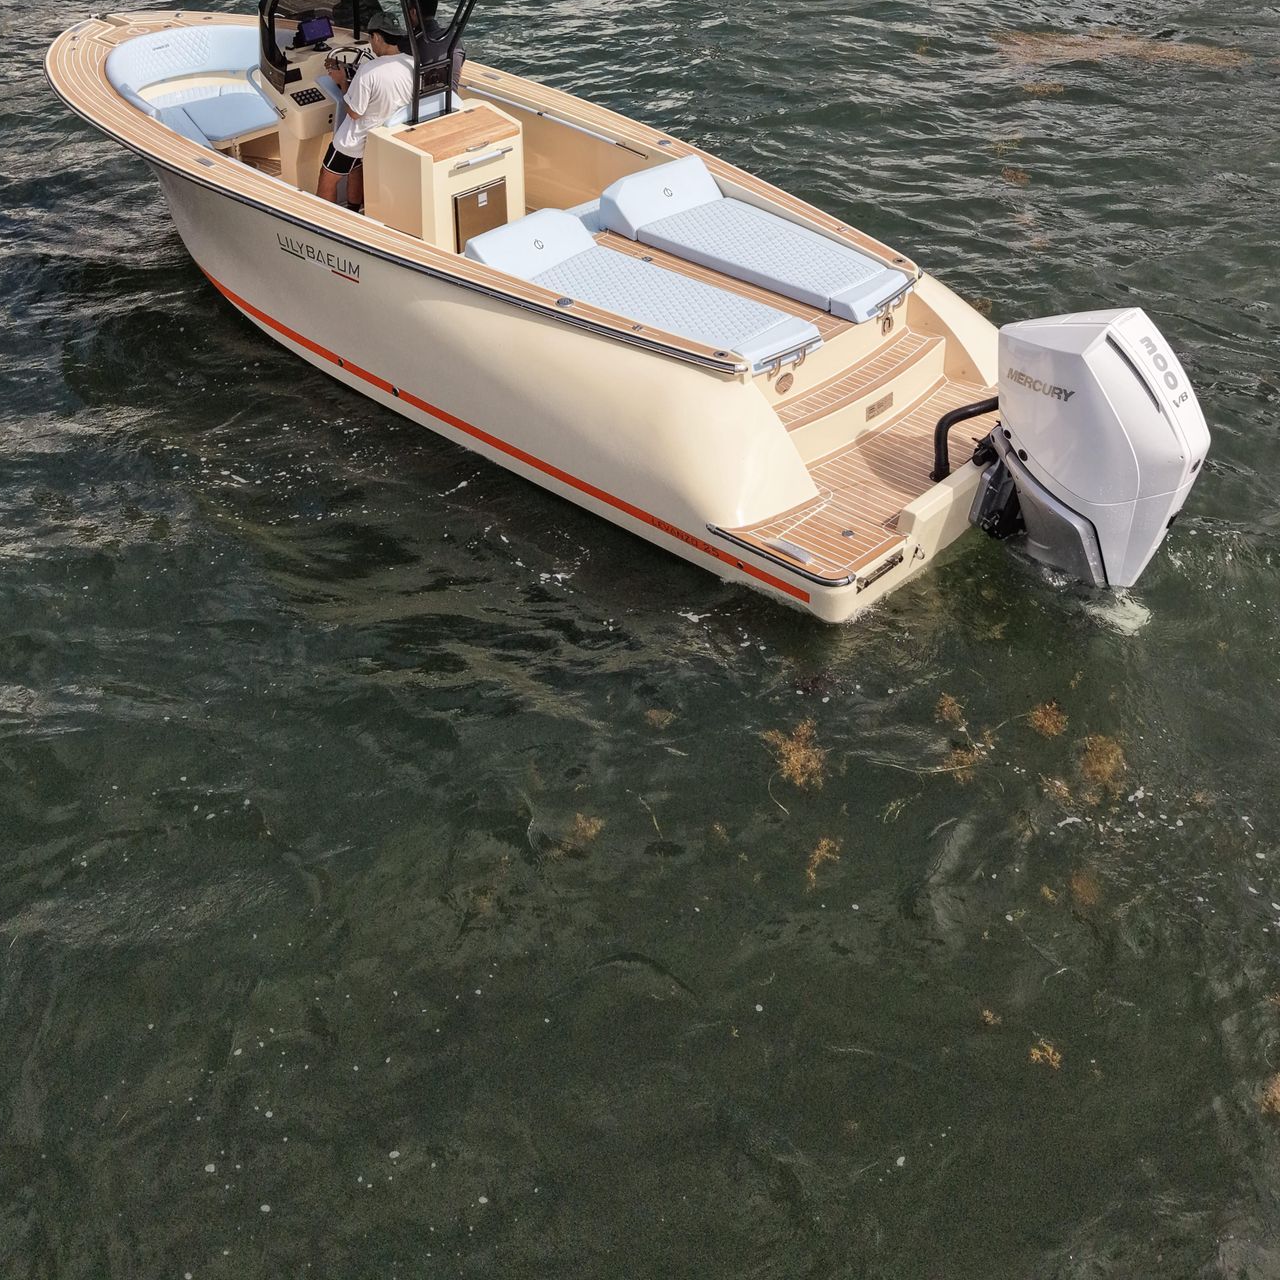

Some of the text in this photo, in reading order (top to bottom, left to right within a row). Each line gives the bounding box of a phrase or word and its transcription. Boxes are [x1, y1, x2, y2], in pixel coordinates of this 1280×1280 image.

[276, 232, 360, 278] LILYBAEUM
[1007, 367, 1076, 402] MERCURY
[1139, 335, 1189, 408] 300 V8
[703, 541, 720, 557] 25
